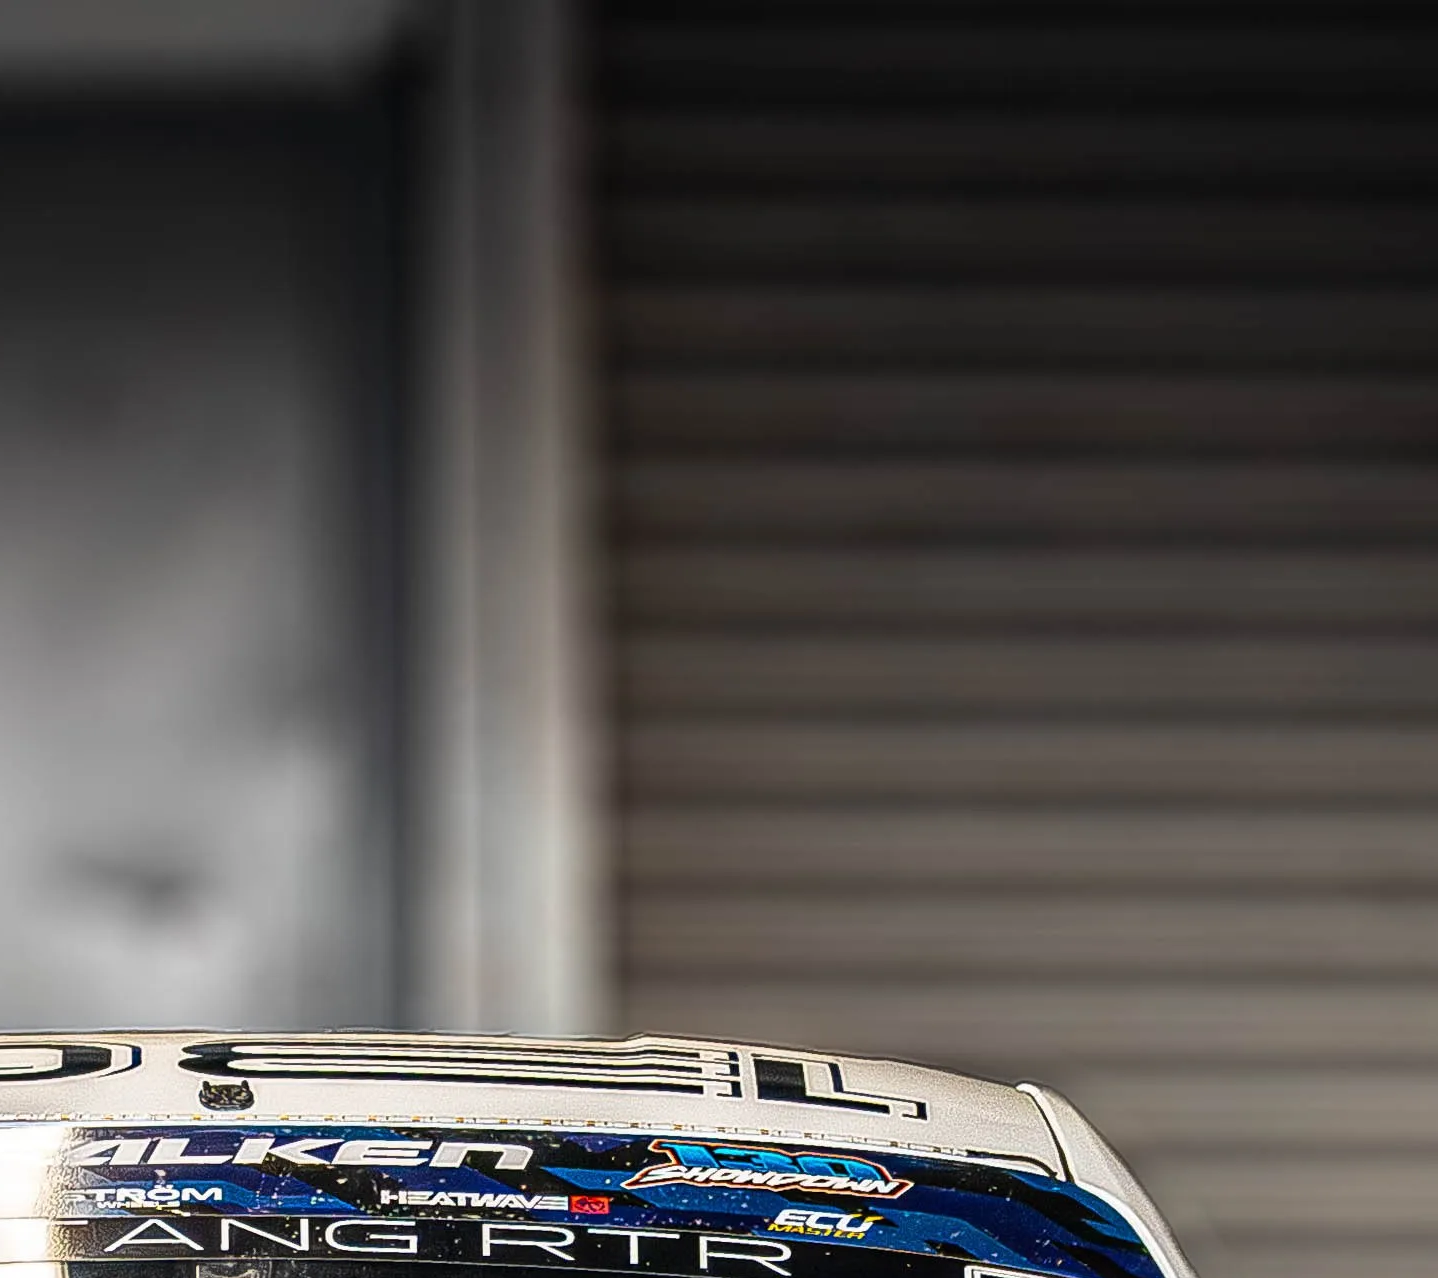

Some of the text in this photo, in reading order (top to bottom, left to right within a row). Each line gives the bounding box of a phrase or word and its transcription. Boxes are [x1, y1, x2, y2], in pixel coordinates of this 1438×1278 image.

[59, 1136, 535, 1171] ALKEN
[661, 1142, 882, 1181] 130
[639, 1164, 901, 1195] SHOWDOWN
[380, 1189, 569, 1211] HEATWAVE
[767, 1223, 867, 1240] MASTER
[773, 1208, 884, 1233] ECU
[482, 1222, 793, 1277] RTR
